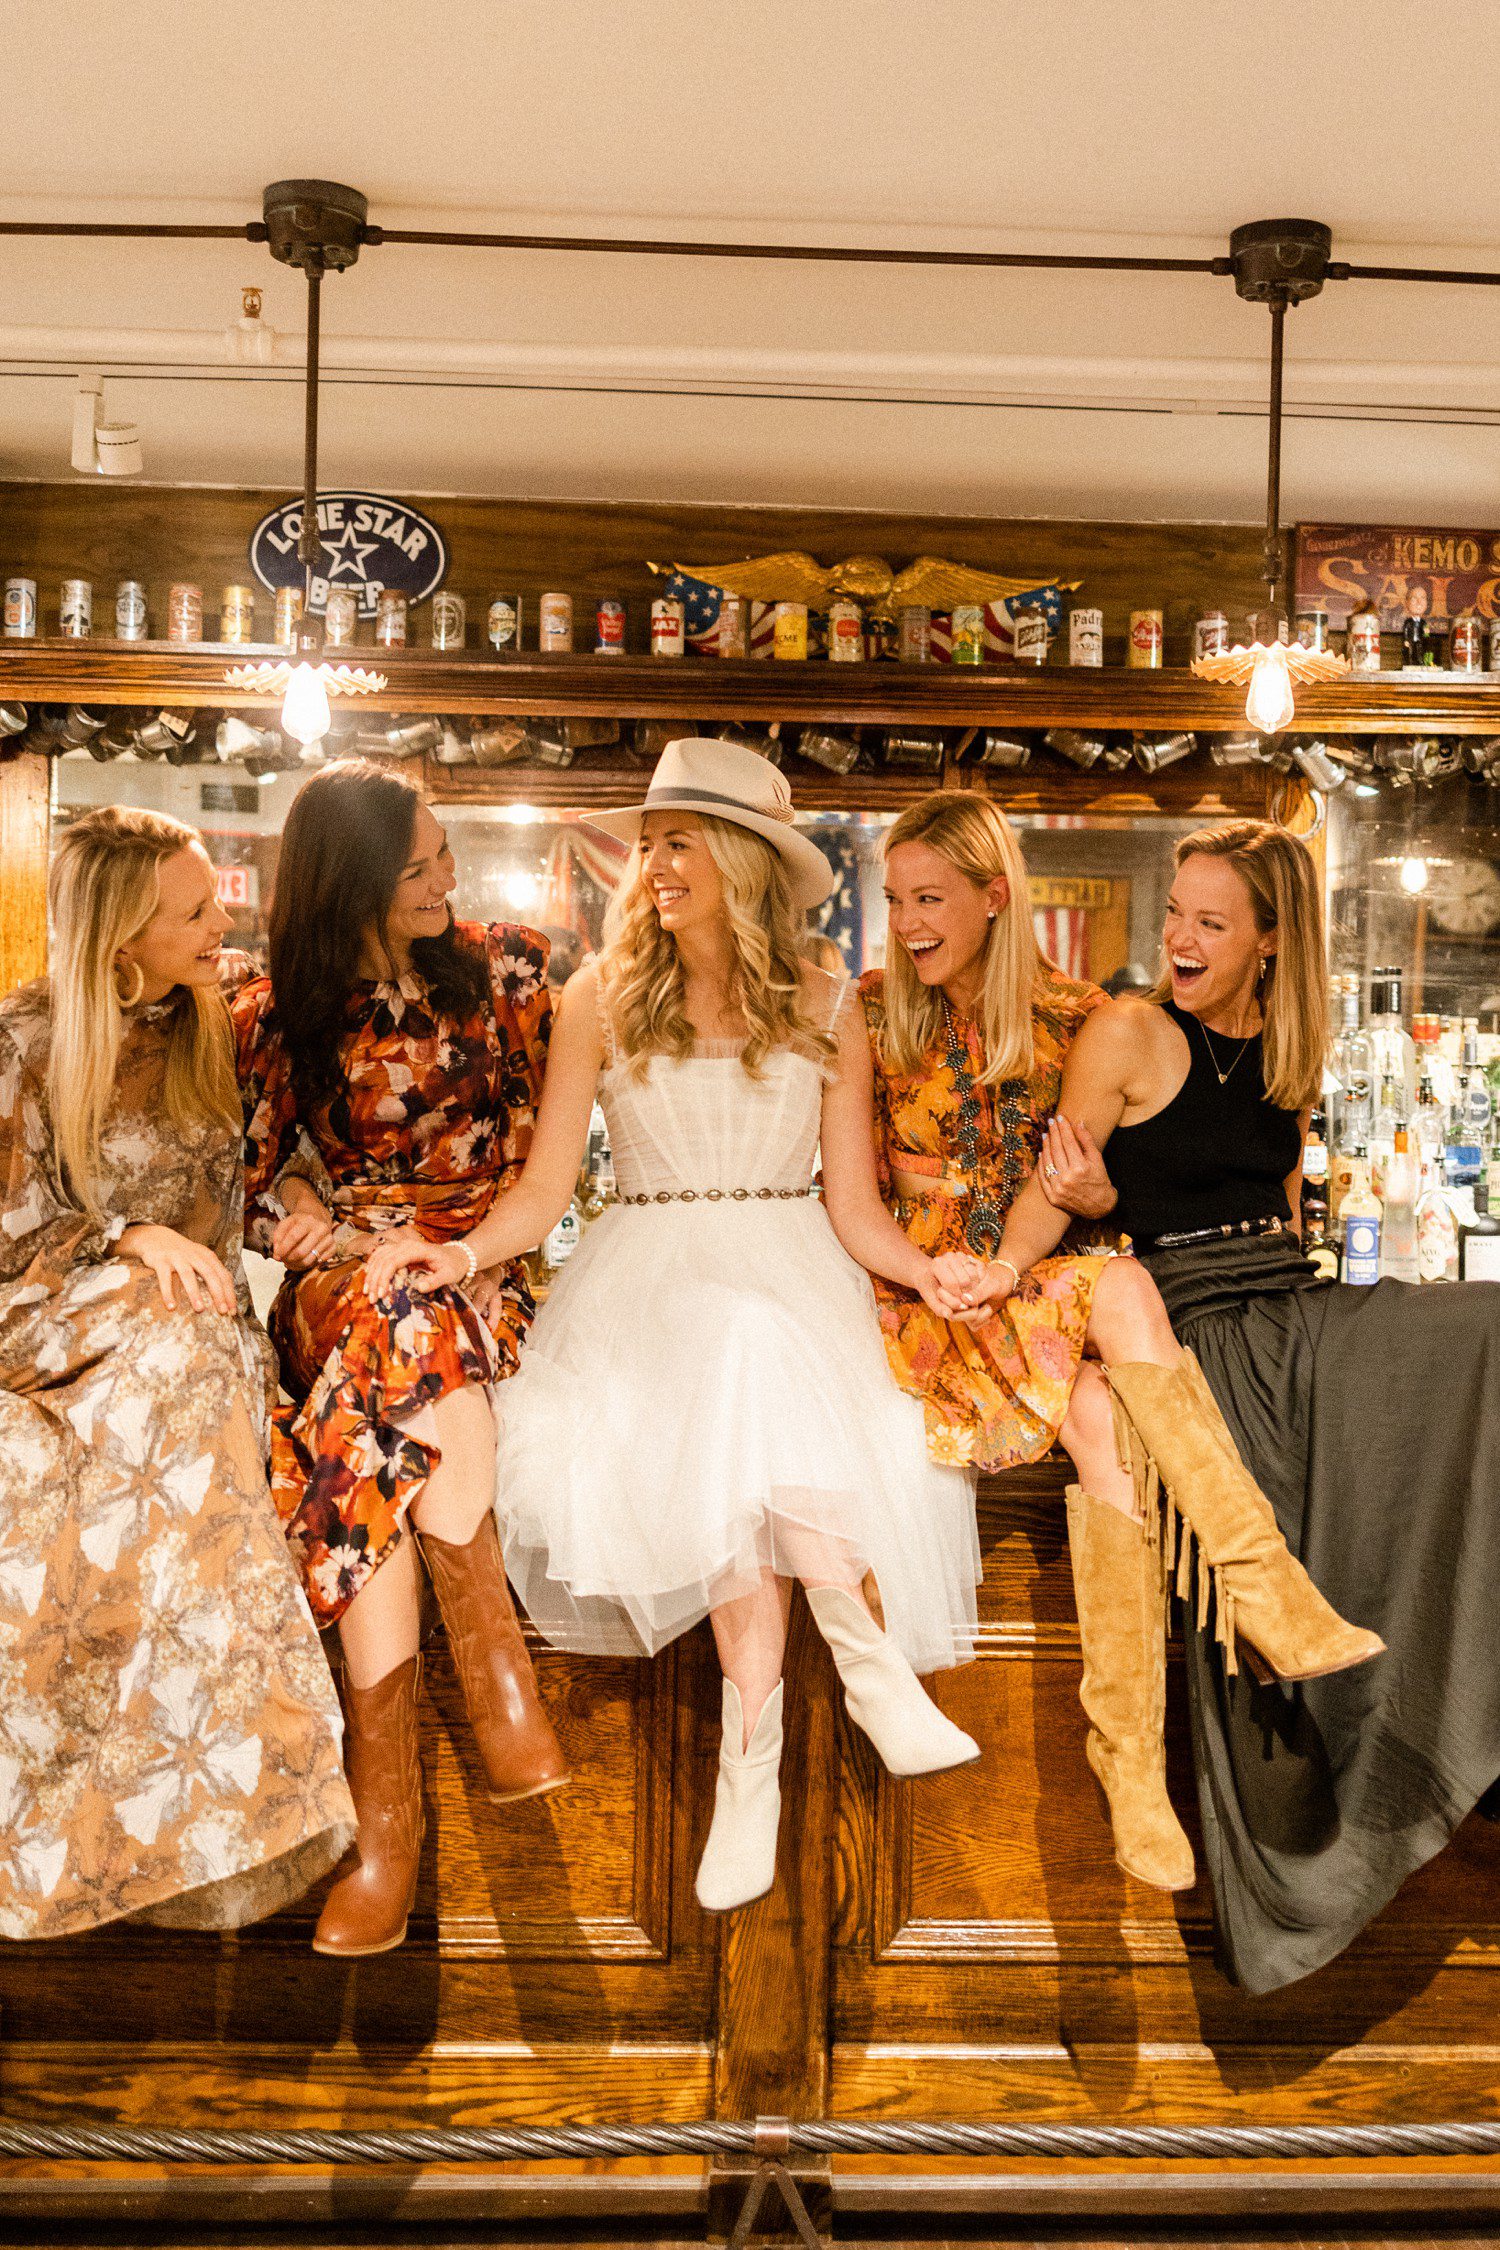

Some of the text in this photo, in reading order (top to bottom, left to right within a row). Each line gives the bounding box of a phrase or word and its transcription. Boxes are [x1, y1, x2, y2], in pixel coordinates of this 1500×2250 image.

[353, 504, 428, 562] STAR
[1394, 536, 1480, 572] KEMO
[652, 620, 678, 631] JAX
